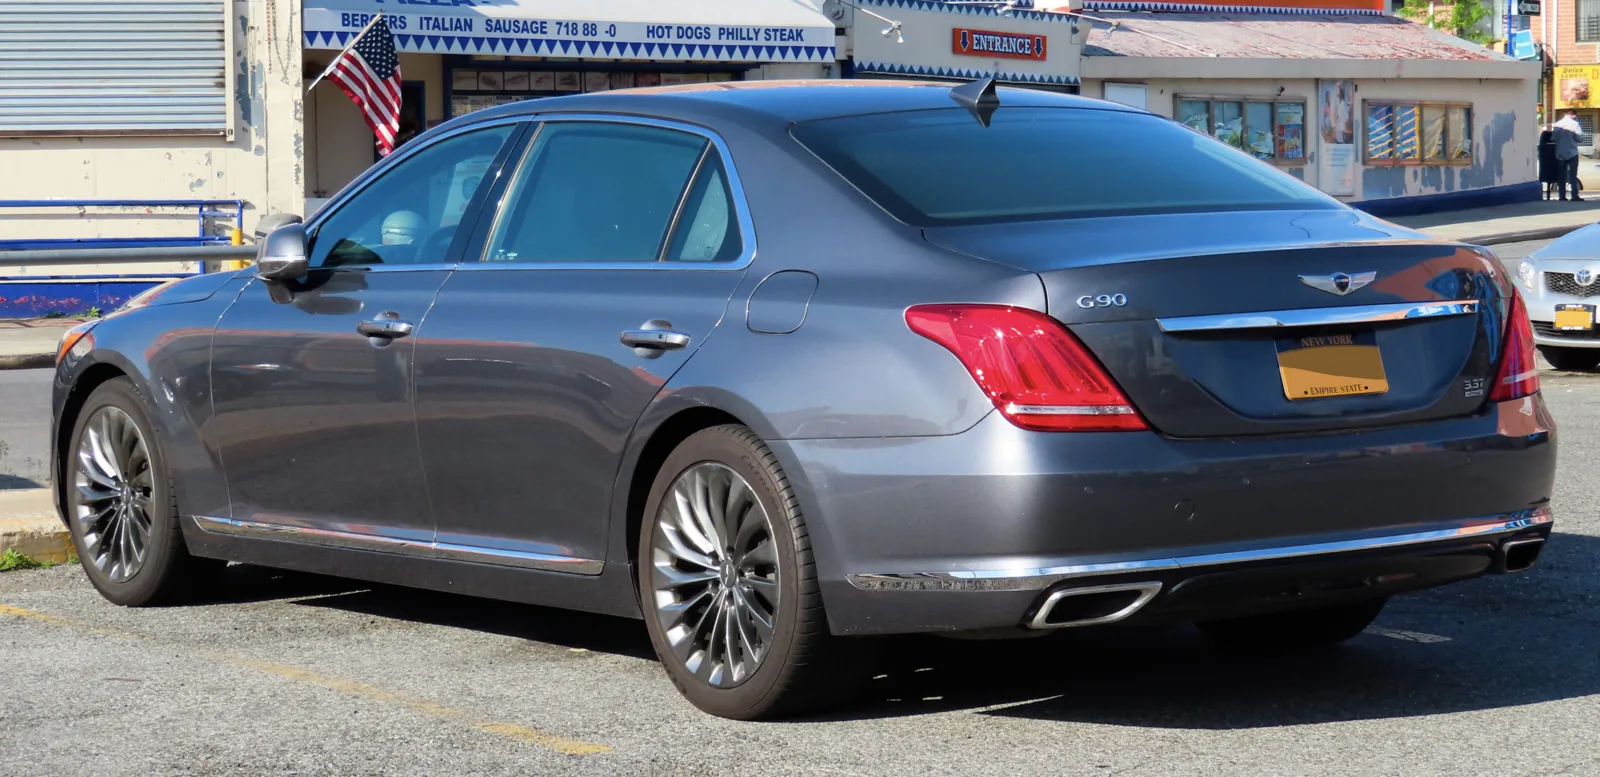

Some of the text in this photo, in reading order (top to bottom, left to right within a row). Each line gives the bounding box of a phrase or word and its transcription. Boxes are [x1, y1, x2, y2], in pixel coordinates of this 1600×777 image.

[341, 12, 407, 30] BERRS
[419, 16, 473, 32] ITALIAN
[485, 18, 548, 35] SAUSAGE
[556, 21, 579, 36] 718
[582, 22, 598, 37] 88
[646, 25, 673, 39] HOT
[676, 26, 711, 40] DOGS
[718, 27, 761, 41] PHILLY
[764, 28, 804, 42] STEAK
[972, 33, 1032, 54] ENTRANCE
[1076, 293, 1128, 309] G90
[1301, 334, 1354, 348] NEW YORK
[1310, 383, 1363, 396] EMPIRE STATE
